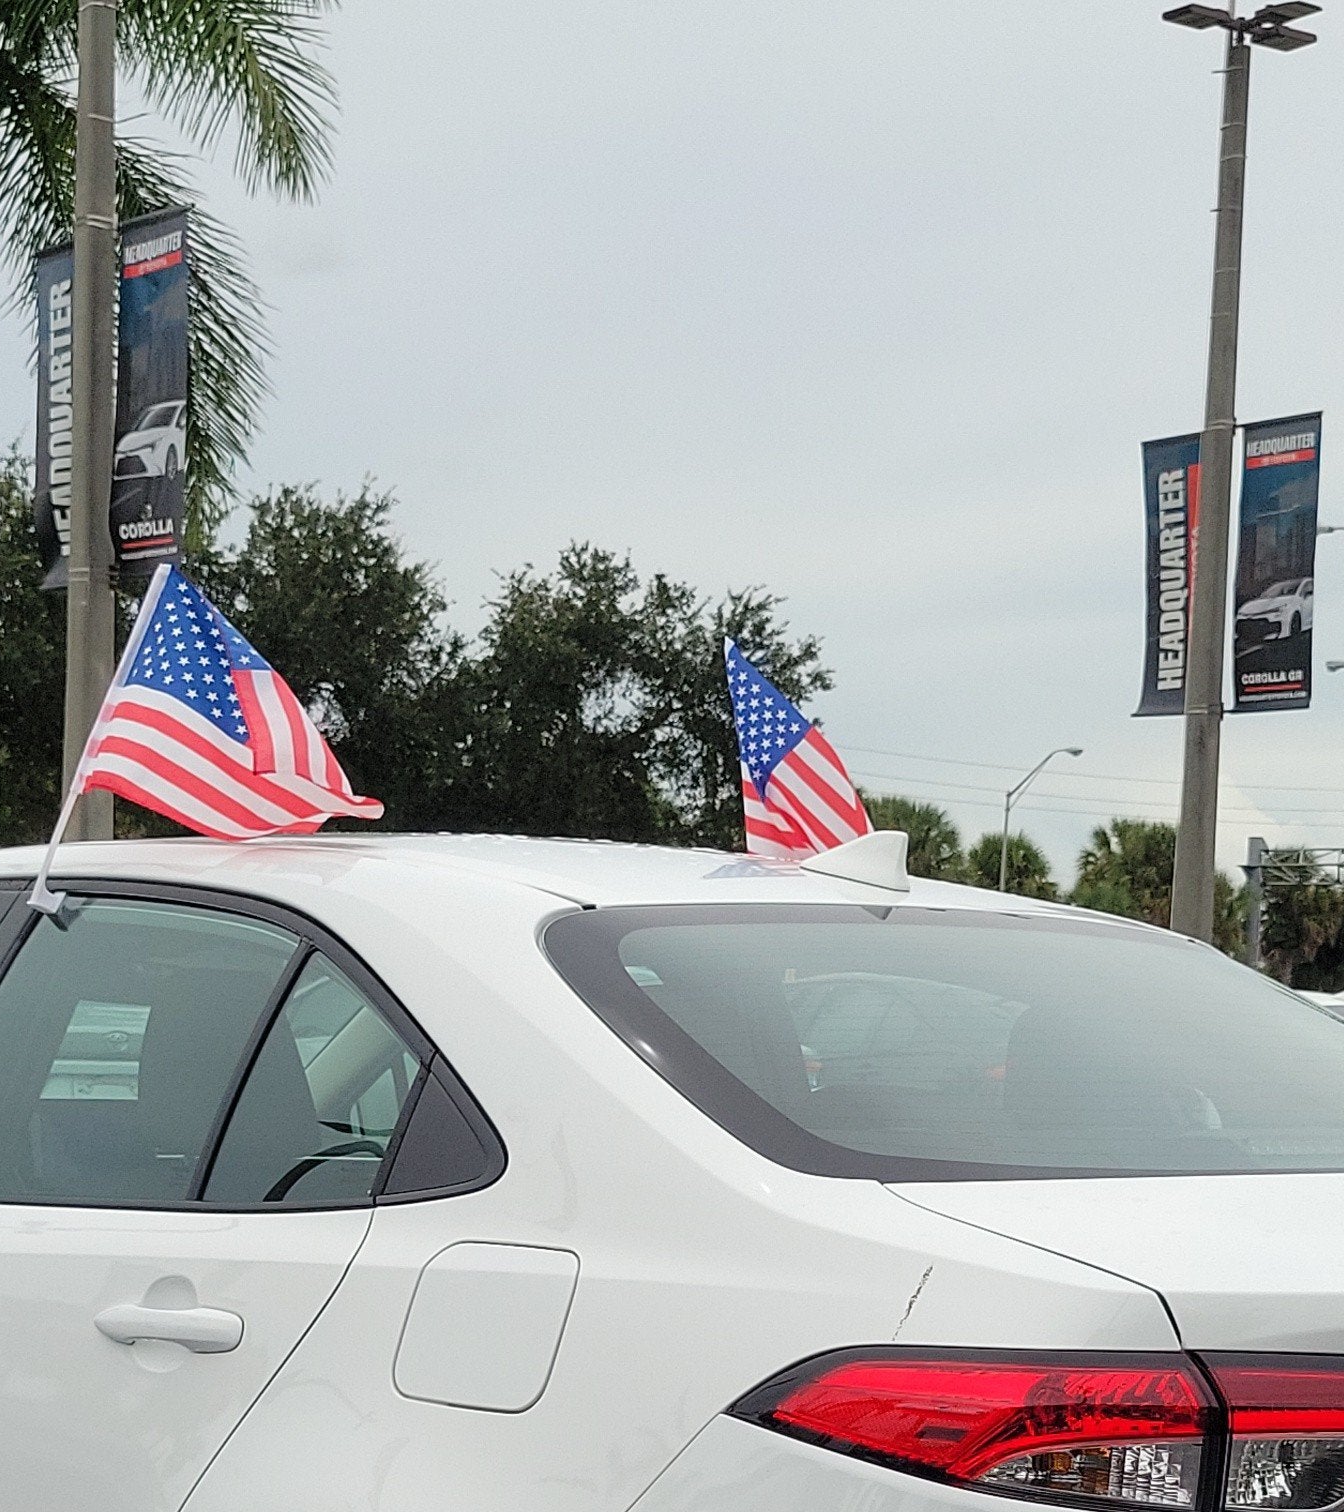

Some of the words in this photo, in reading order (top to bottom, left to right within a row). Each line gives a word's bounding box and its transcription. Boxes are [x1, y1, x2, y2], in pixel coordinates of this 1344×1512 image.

[123, 230, 183, 265] HEADQUARTER
[1246, 432, 1315, 458] HEADQUARTER
[118, 518, 174, 540] COROLLA
[1158, 467, 1188, 691] HEADQUARTER
[1241, 671, 1287, 685] COROLLA
